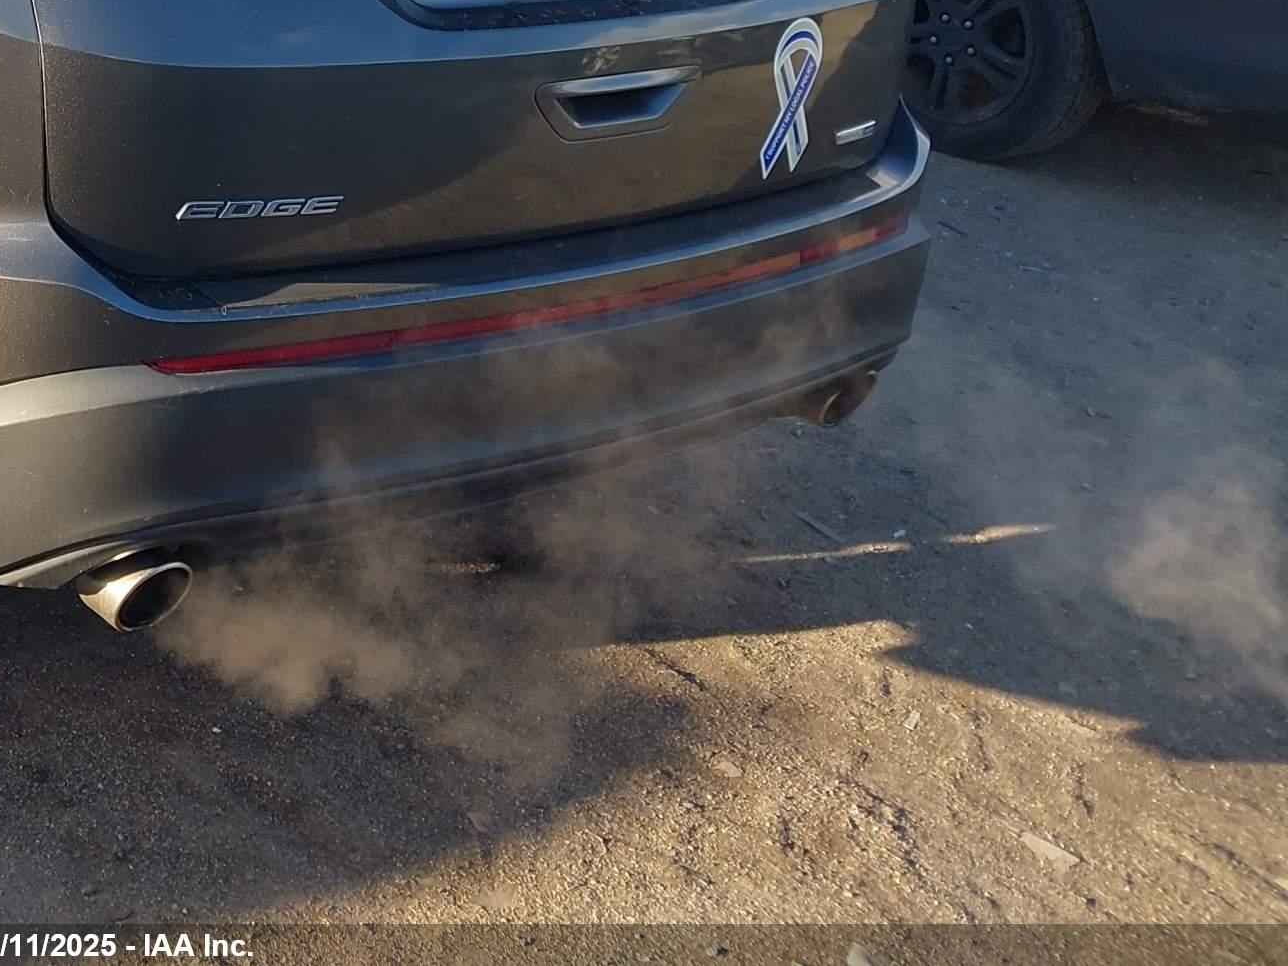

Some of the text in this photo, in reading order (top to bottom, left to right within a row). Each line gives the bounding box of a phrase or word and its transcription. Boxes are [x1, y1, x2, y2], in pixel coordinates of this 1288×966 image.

[767, 123, 787, 156] SUPPORT
[783, 111, 792, 123] MY
[789, 89, 803, 111] LOCAL
[800, 61, 814, 88] POLICE
[175, 195, 344, 221] EDGE
